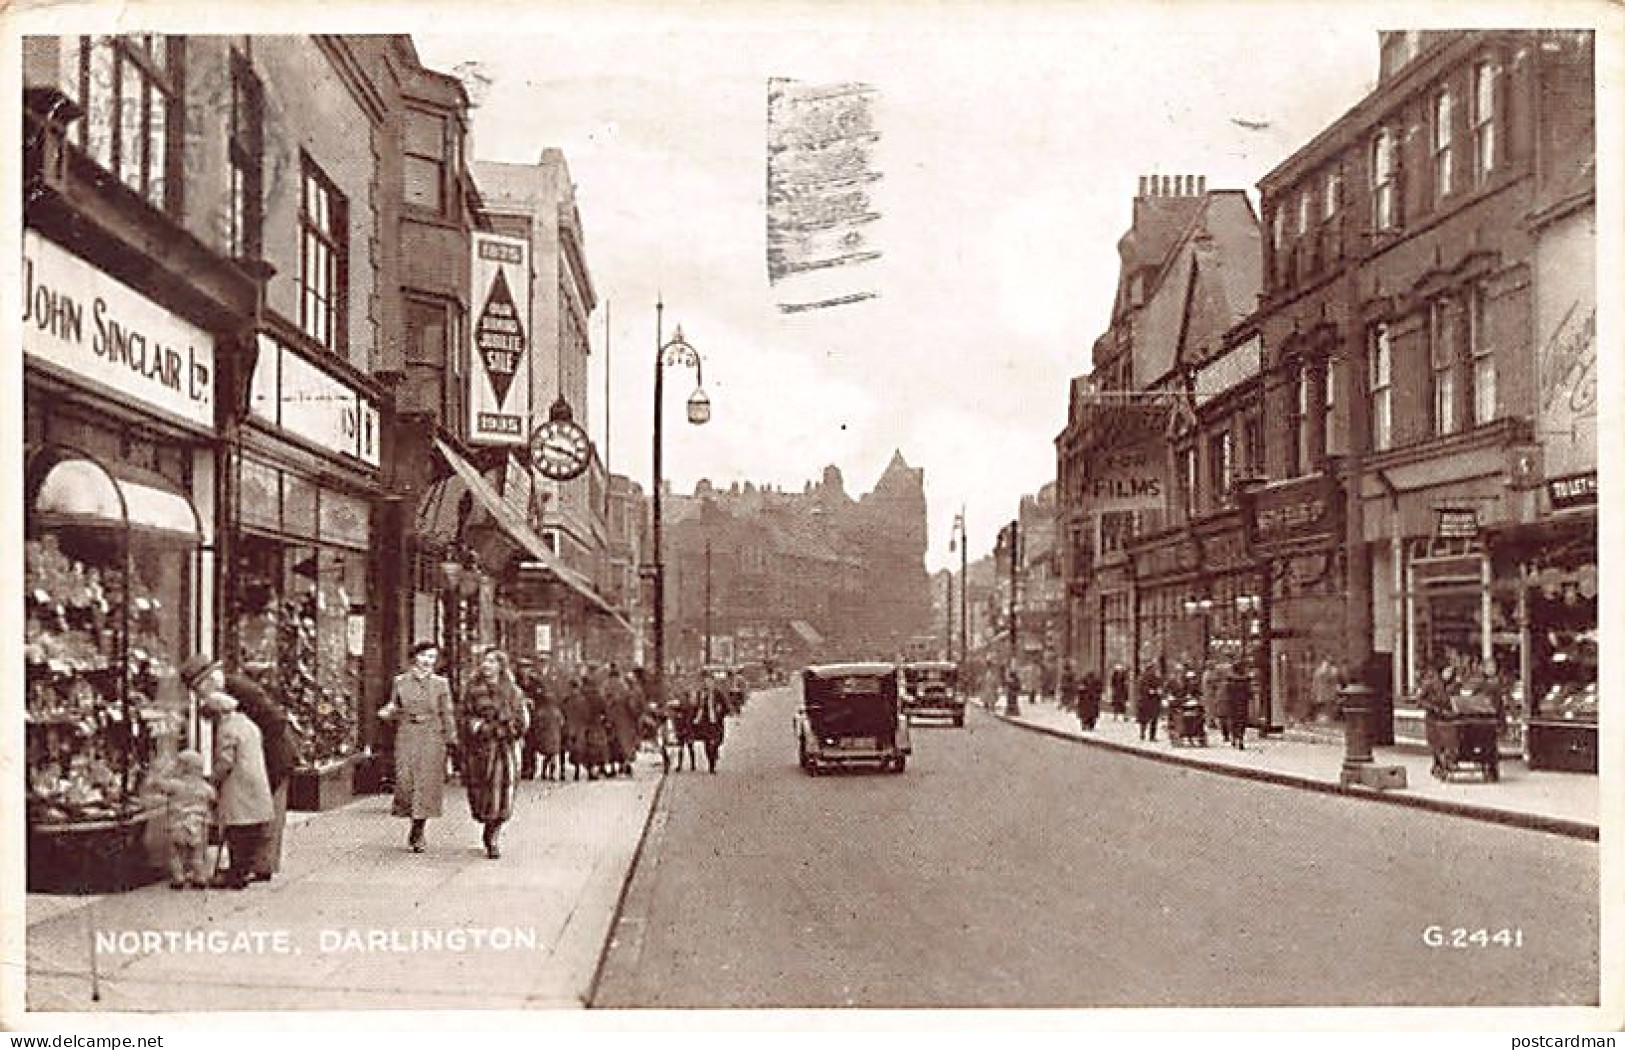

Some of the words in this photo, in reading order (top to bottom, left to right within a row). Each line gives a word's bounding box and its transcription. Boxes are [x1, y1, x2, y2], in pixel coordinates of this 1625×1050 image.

[22, 258, 82, 344] JOHN
[92, 297, 182, 392] SINCLAIR
[480, 415, 518, 433] 1935
[1093, 477, 1161, 498] FILMS
